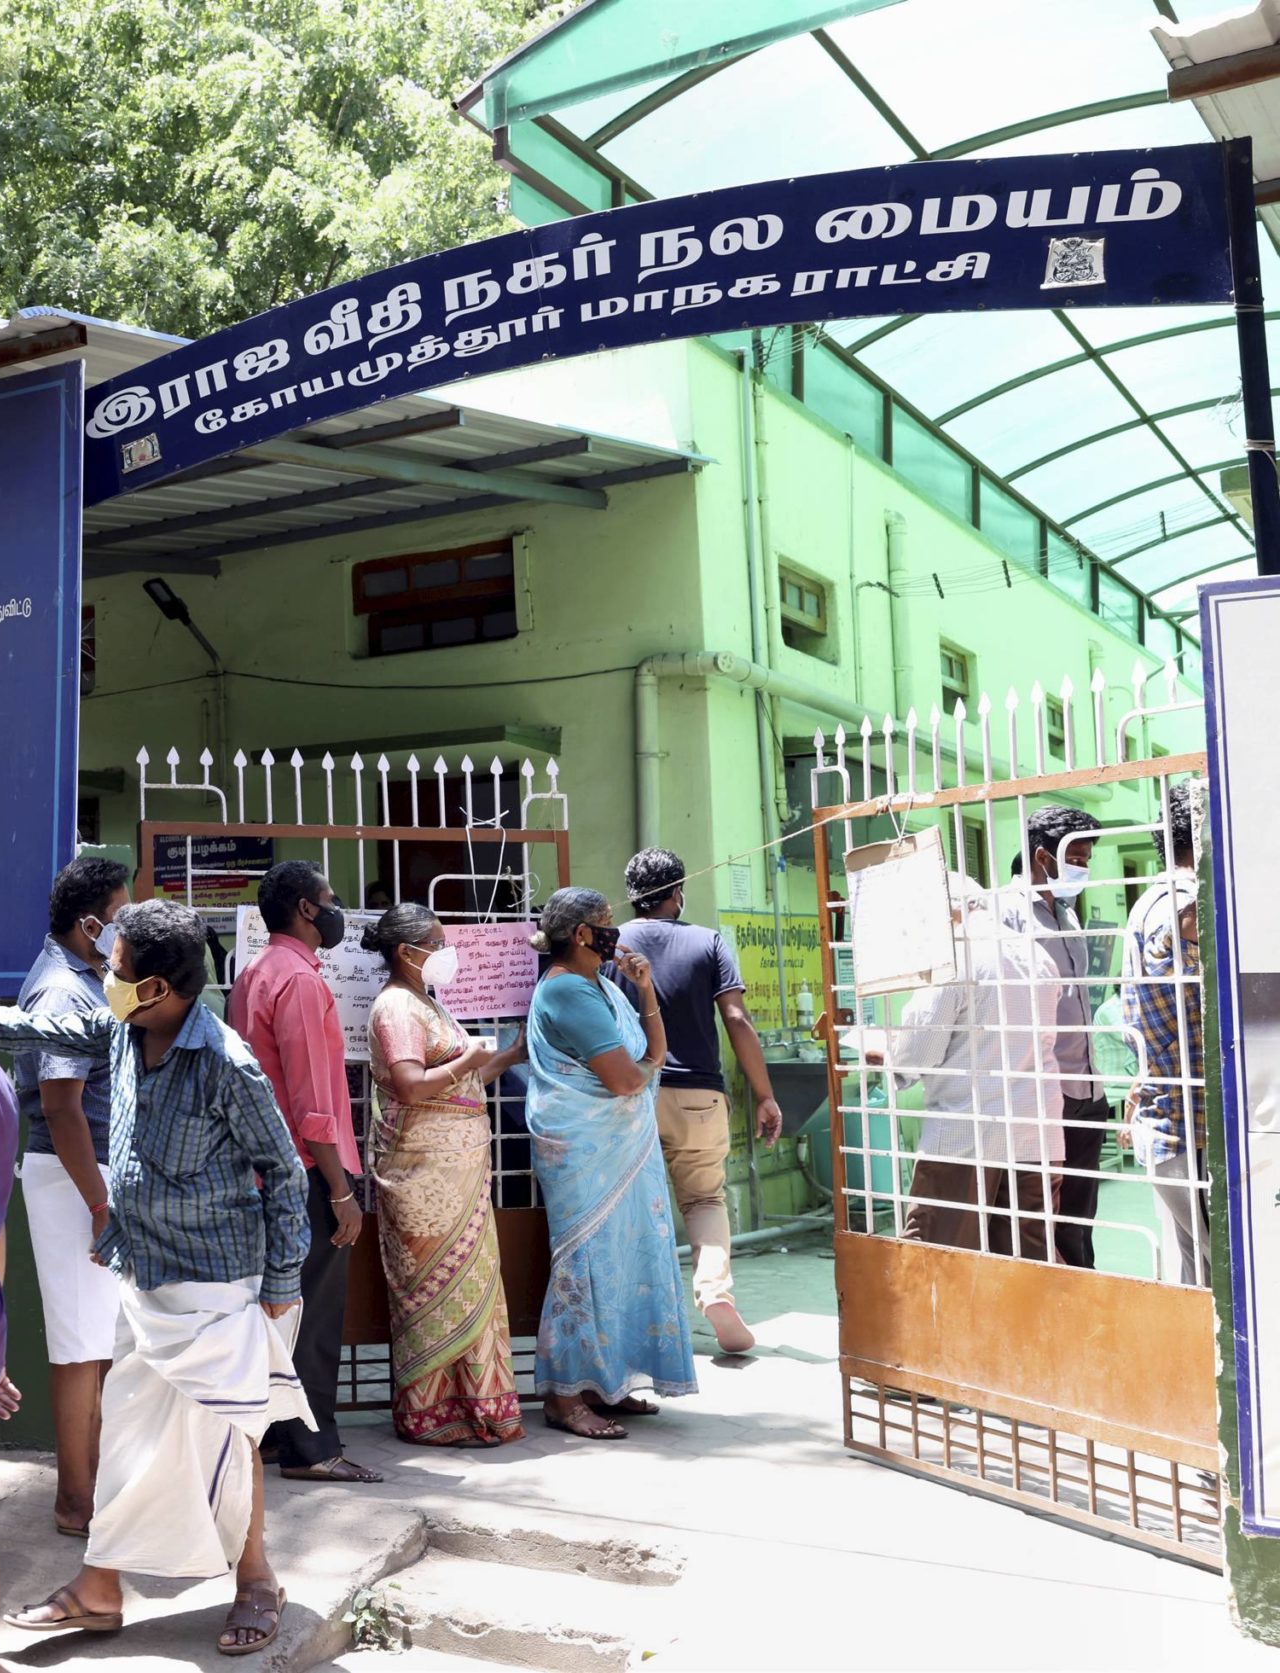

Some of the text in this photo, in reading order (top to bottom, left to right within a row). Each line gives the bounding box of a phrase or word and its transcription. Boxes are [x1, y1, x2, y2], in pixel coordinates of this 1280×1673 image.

[86, 167, 1184, 439] இராஜ வீதி நகர் நல மையம்
[194, 250, 991, 435] கோயமுத்தூர் மாநகராட்சி
